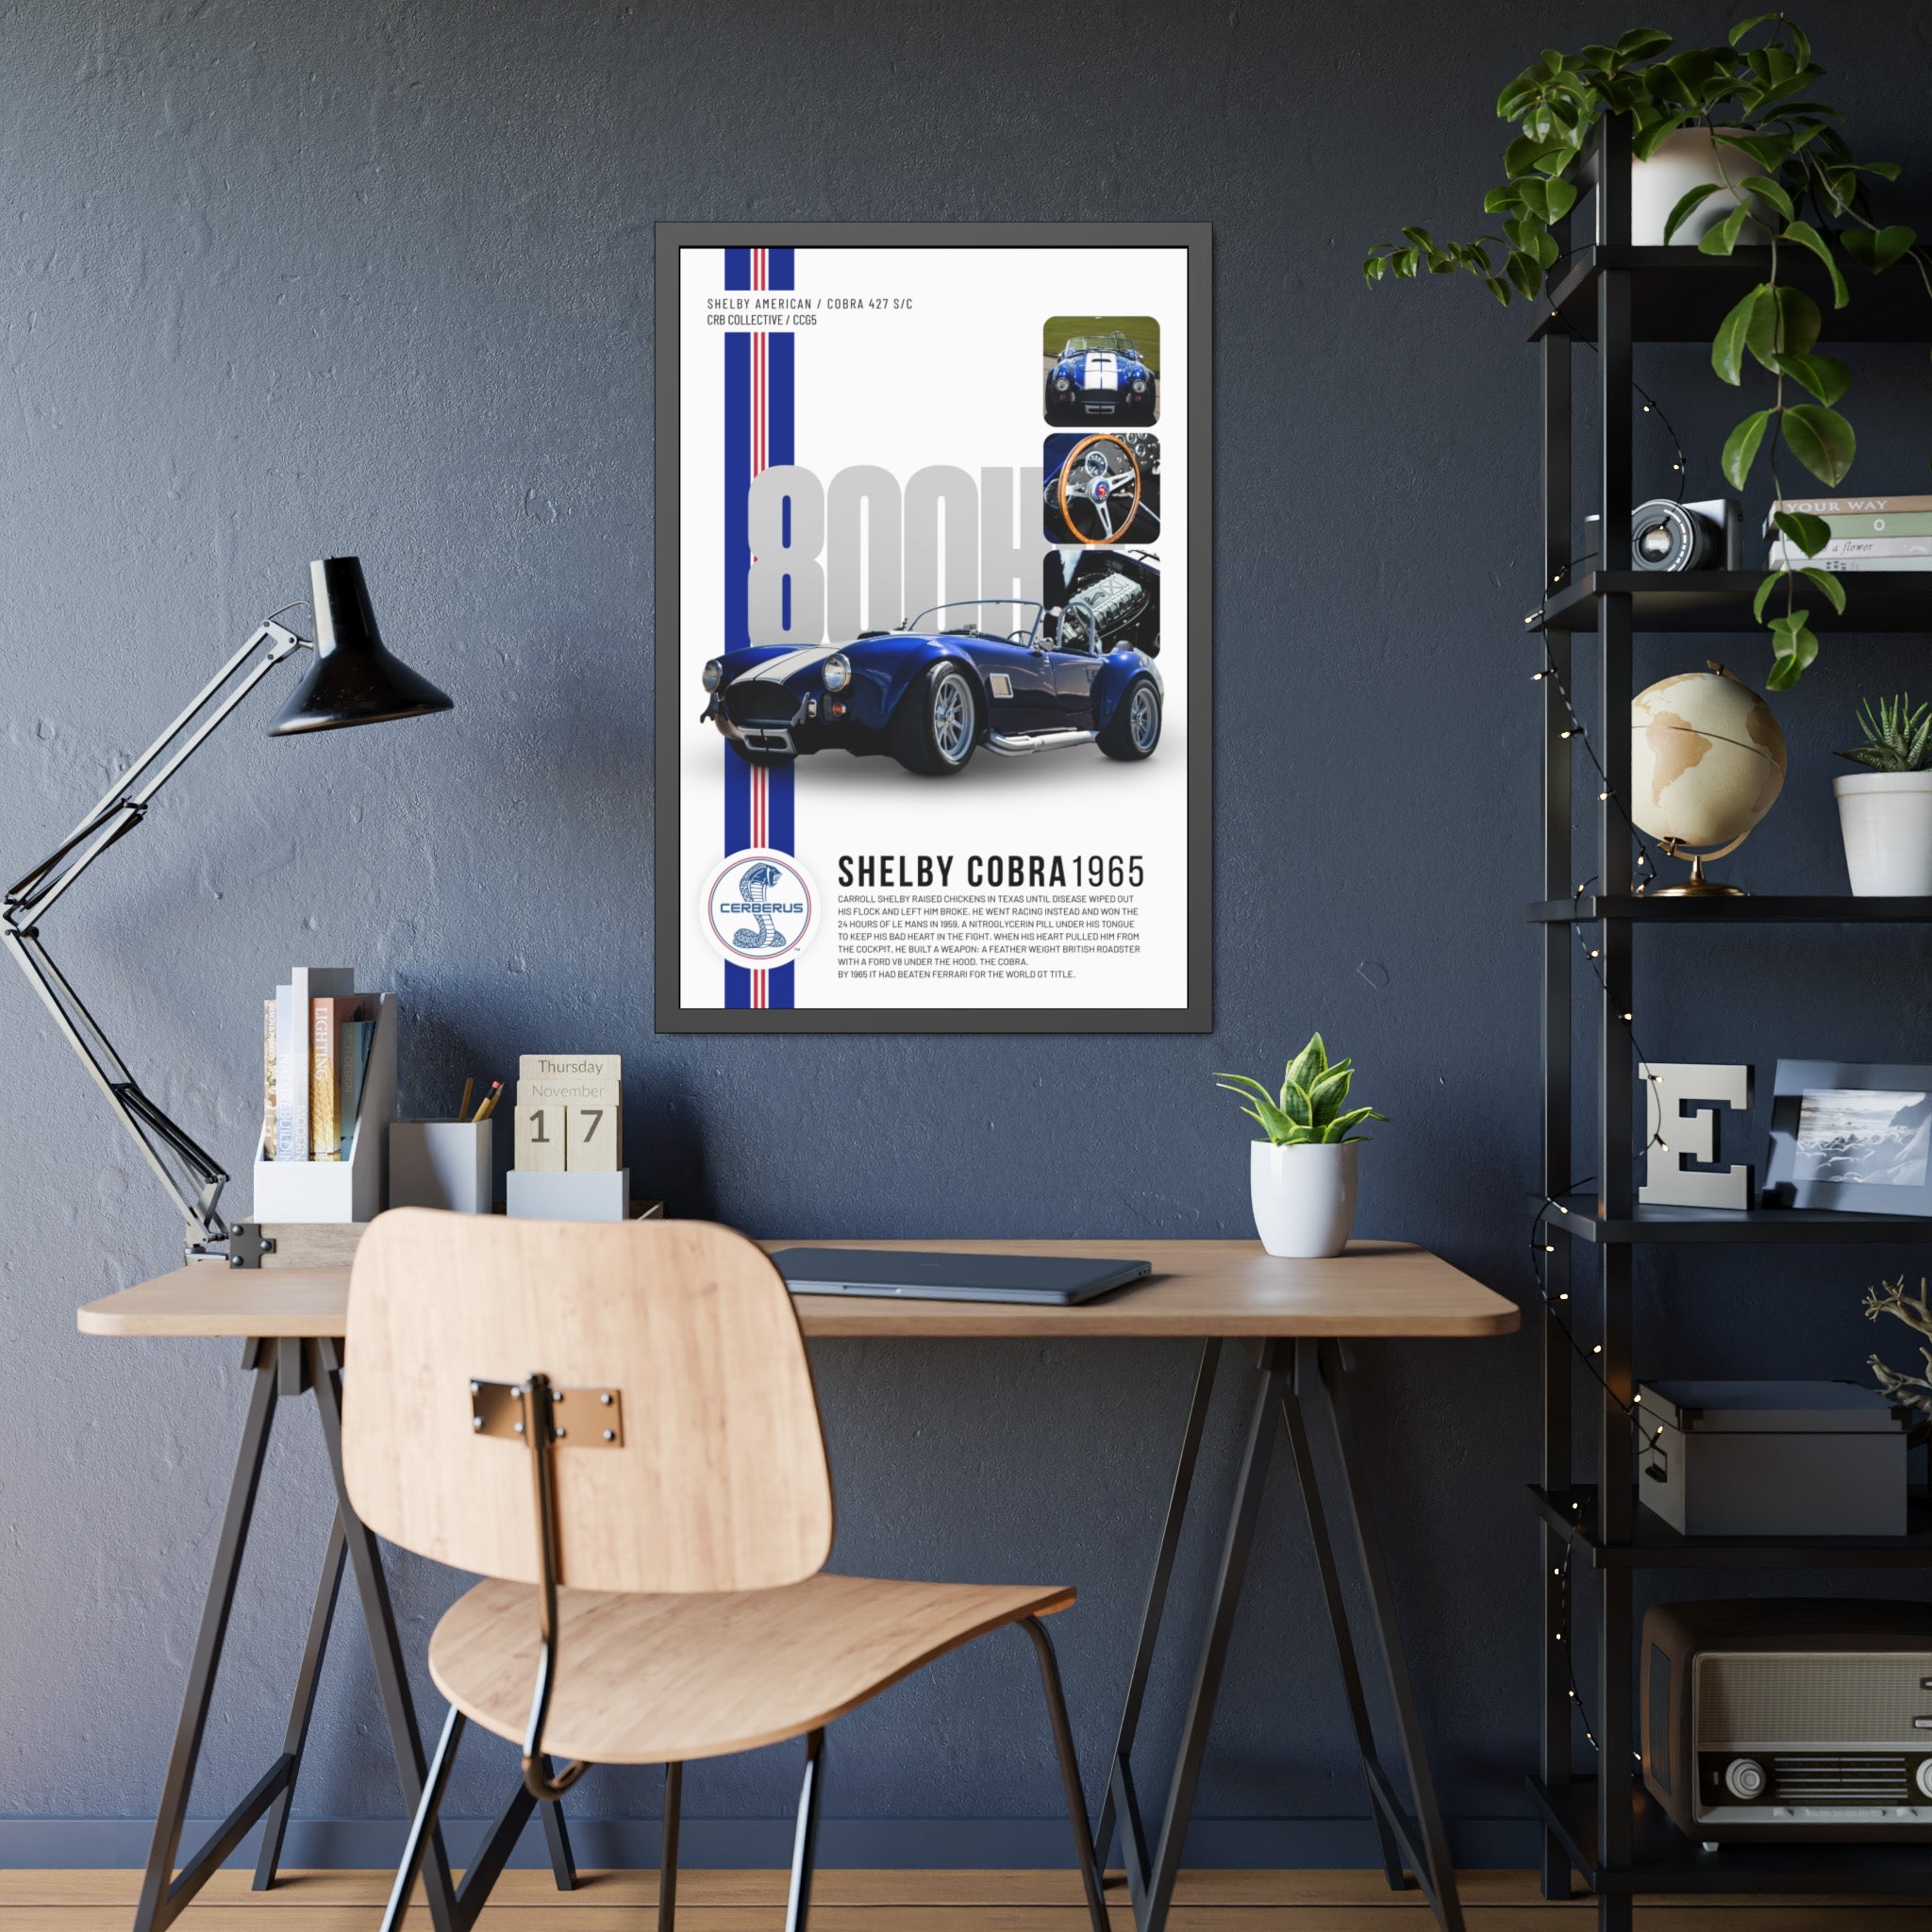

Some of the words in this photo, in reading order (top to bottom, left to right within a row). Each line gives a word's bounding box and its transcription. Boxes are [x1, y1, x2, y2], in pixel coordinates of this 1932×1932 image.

[708, 298, 750, 309] SHELBY
[755, 298, 811, 309] AMERICAN
[817, 298, 822, 309] /
[827, 298, 864, 309] COBRA
[868, 298, 889, 309] 427
[893, 298, 912, 309] S/C
[708, 314, 725, 325] CRB
[728, 314, 783, 325] COLLECTIVE
[786, 314, 790, 325] /
[793, 314, 817, 325] CCG5
[1787, 502, 1840, 512] YOUR
[1848, 500, 1889, 510] WAY
[1840, 541, 1874, 556] flower
[838, 856, 954, 887] SHELBY
[838, 894, 875, 904] CARROLL
[877, 894, 910, 904] SHELBY
[912, 894, 942, 904] RAISED
[944, 894, 986, 904] CHICKENS
[998, 894, 1024, 904] TEXAS
[1026, 894, 1051, 904] UNTIL
[1053, 894, 1087, 904] DISEASE
[1089, 894, 1115, 903] WIPED
[1118, 894, 1134, 904] OUT
[720, 903, 804, 913] CERBERUS
[838, 908, 852, 916] HIS
[853, 908, 880, 916] FLOCK
[882, 908, 899, 916] AND
[901, 908, 922, 916] LEFT
[924, 908, 938, 916] HIM
[940, 908, 970, 916] BROKE.
[973, 908, 984, 916] HE
[986, 908, 1010, 916] WENT
[1012, 908, 1042, 916] RACING
[1045, 908, 1080, 916] INSTEAD
[1081, 908, 1099, 916] AND
[1100, 908, 1120, 916] WON
[1122, 908, 1139, 916] THE
[838, 920, 847, 928] 24
[850, 920, 877, 928] HOURS
[879, 920, 891, 928] OF
[892, 920, 903, 928] LE
[905, 920, 928, 928] MANS
[930, 920, 938, 928] IN
[941, 920, 959, 928] 1959,
[961, 920, 967, 928] A
[969, 920, 1034, 928] NITROGLYCERIN
[1036, 920, 1054, 928] PILL
[1056, 920, 1084, 928] UNDER
[1086, 920, 1100, 928] HIS
[1102, 920, 1135, 928] TONGUE
[838, 932, 848, 941] TO
[851, 932, 872, 941] KEEP
[874, 932, 887, 941] HIS
[890, 932, 906, 941] BAD
[908, 932, 935, 941] HEART
[947, 932, 963, 941] THE
[966, 932, 991, 941] FIGHT.
[993, 932, 1019, 941] WHEN
[1021, 932, 1034, 941] HIS
[1037, 932, 1064, 941] HEART
[1066, 932, 1098, 941] PULLED
[1117, 932, 1139, 941] FROM
[838, 945, 855, 954] THE
[857, 945, 893, 954] COCKPIT,
[895, 945, 907, 954] HE
[908, 945, 932, 954] BUILT
[941, 945, 979, 954] WEAPON:
[990, 945, 1026, 954] FEATHER
[1028, 945, 1060, 954] WEIGHT
[1062, 945, 1094, 954] BRITISH
[1096, 945, 1140, 954] ROADSTER
[838, 958, 858, 966] WITH
[861, 958, 866, 966] A
[869, 958, 890, 966] FORD
[892, 958, 902, 966] V8
[905, 958, 932, 966] UNDER
[935, 958, 950, 966] THE
[953, 958, 977, 966] HOOD.
[980, 958, 995, 966] THE
[998, 958, 1028, 966] COBRA.
[839, 970, 848, 978] BY
[851, 970, 868, 978] 1965
[870, 970, 876, 978] IT
[879, 970, 895, 978] HAD
[898, 970, 930, 978] BEATEN
[933, 970, 967, 978] FERRARI
[970, 970, 986, 978] FOR
[989, 970, 1004, 978] THE
[1006, 970, 1036, 978] WORLD
[1038, 970, 1047, 978] GT
[1050, 970, 1074, 978] TITLE.
[314, 1008, 328, 1081] LIGHTING
[539, 1059, 604, 1075] Thursday
[342, 1056, 353, 1093] DESIGN
[532, 1085, 604, 1097] November
